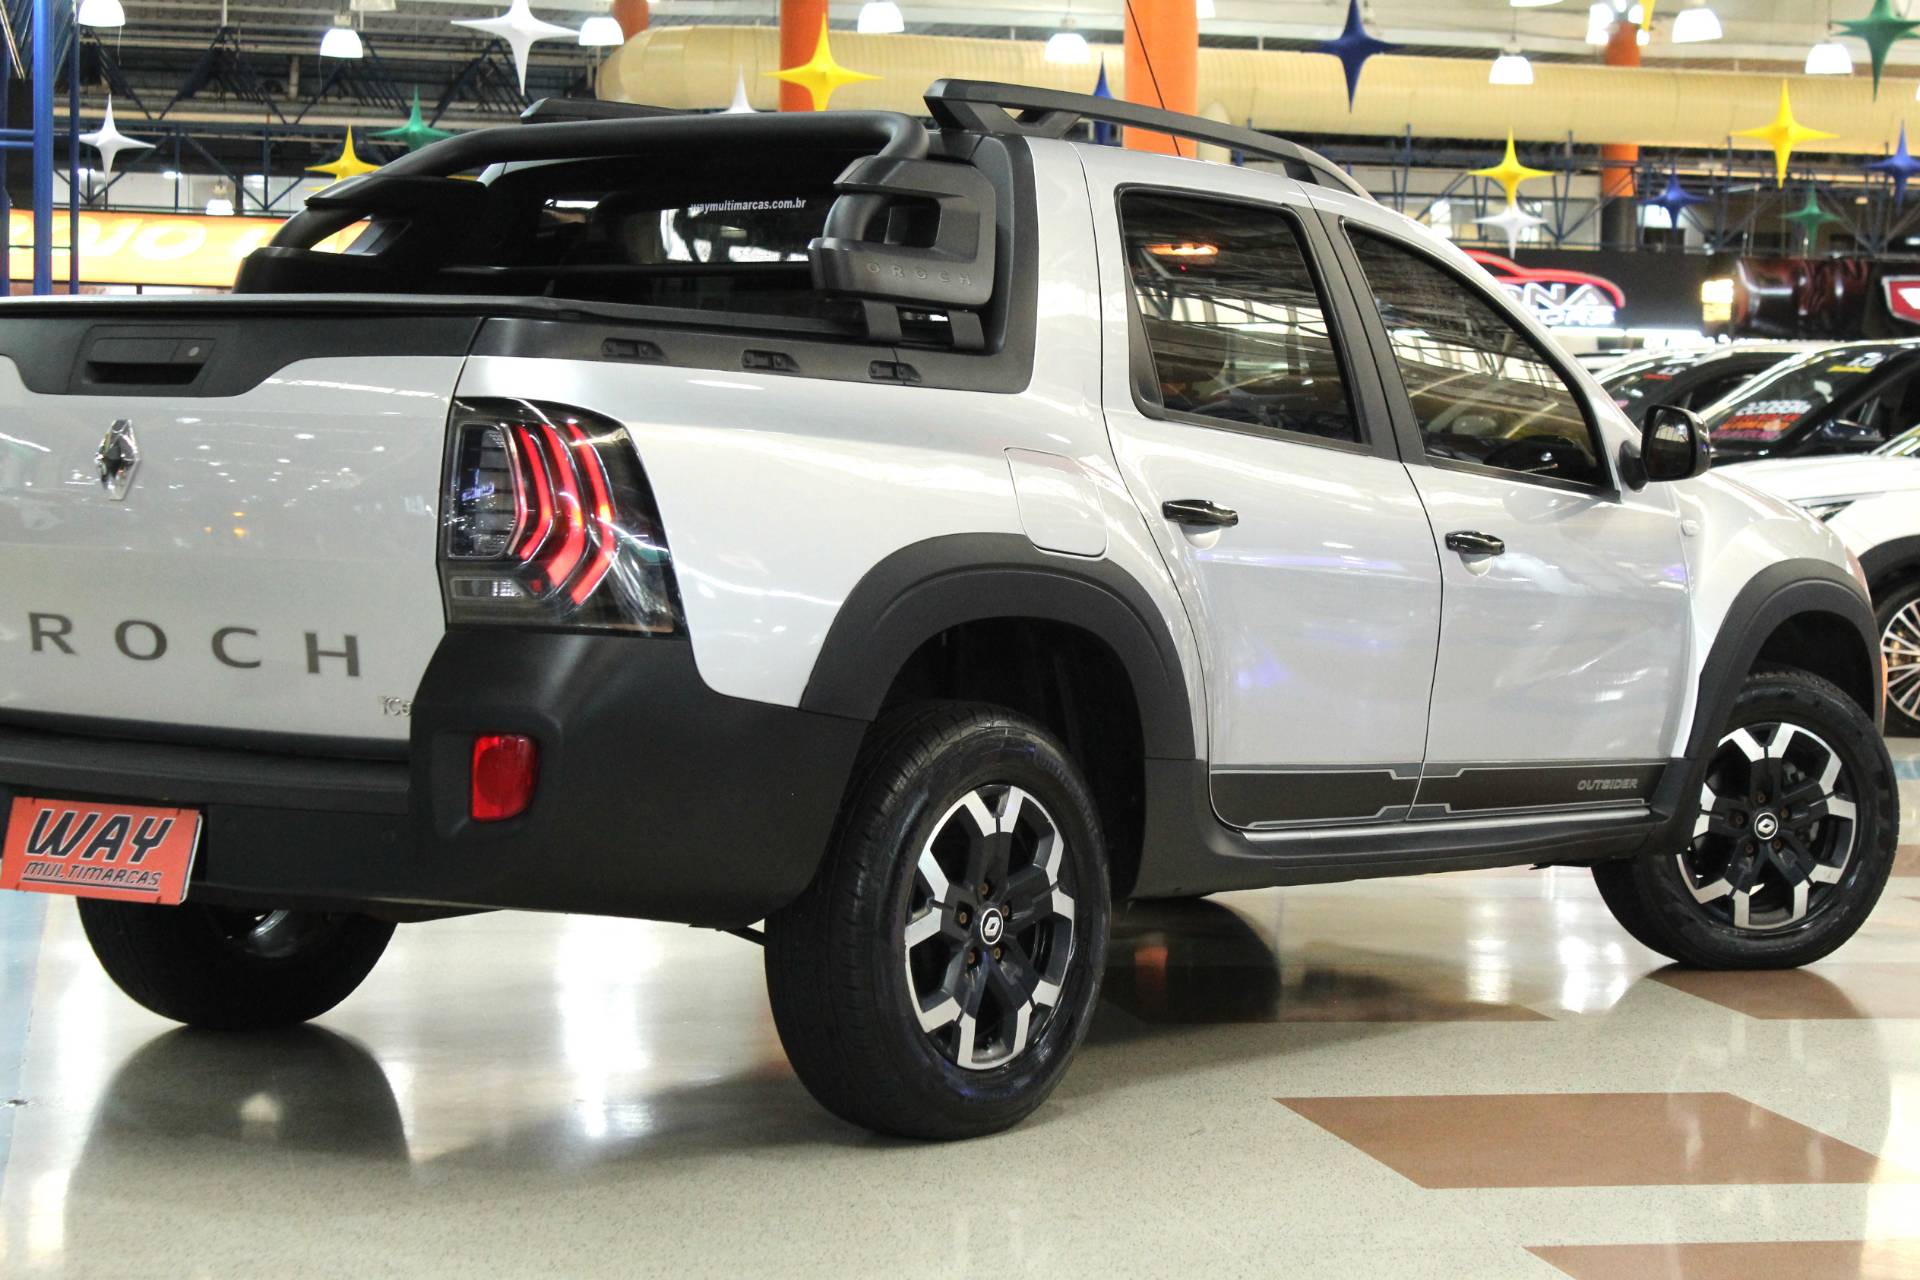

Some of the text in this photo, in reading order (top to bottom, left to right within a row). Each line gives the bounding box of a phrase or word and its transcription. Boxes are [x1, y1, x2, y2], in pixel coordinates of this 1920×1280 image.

[690, 198, 807, 214] waymultimarcas.com.br
[866, 262, 973, 286] OROCH
[27, 611, 362, 678] ROCH
[1576, 778, 1639, 791] OUTSIDER
[25, 808, 176, 865] WAY
[23, 861, 163, 886] MULTIMARCAS
